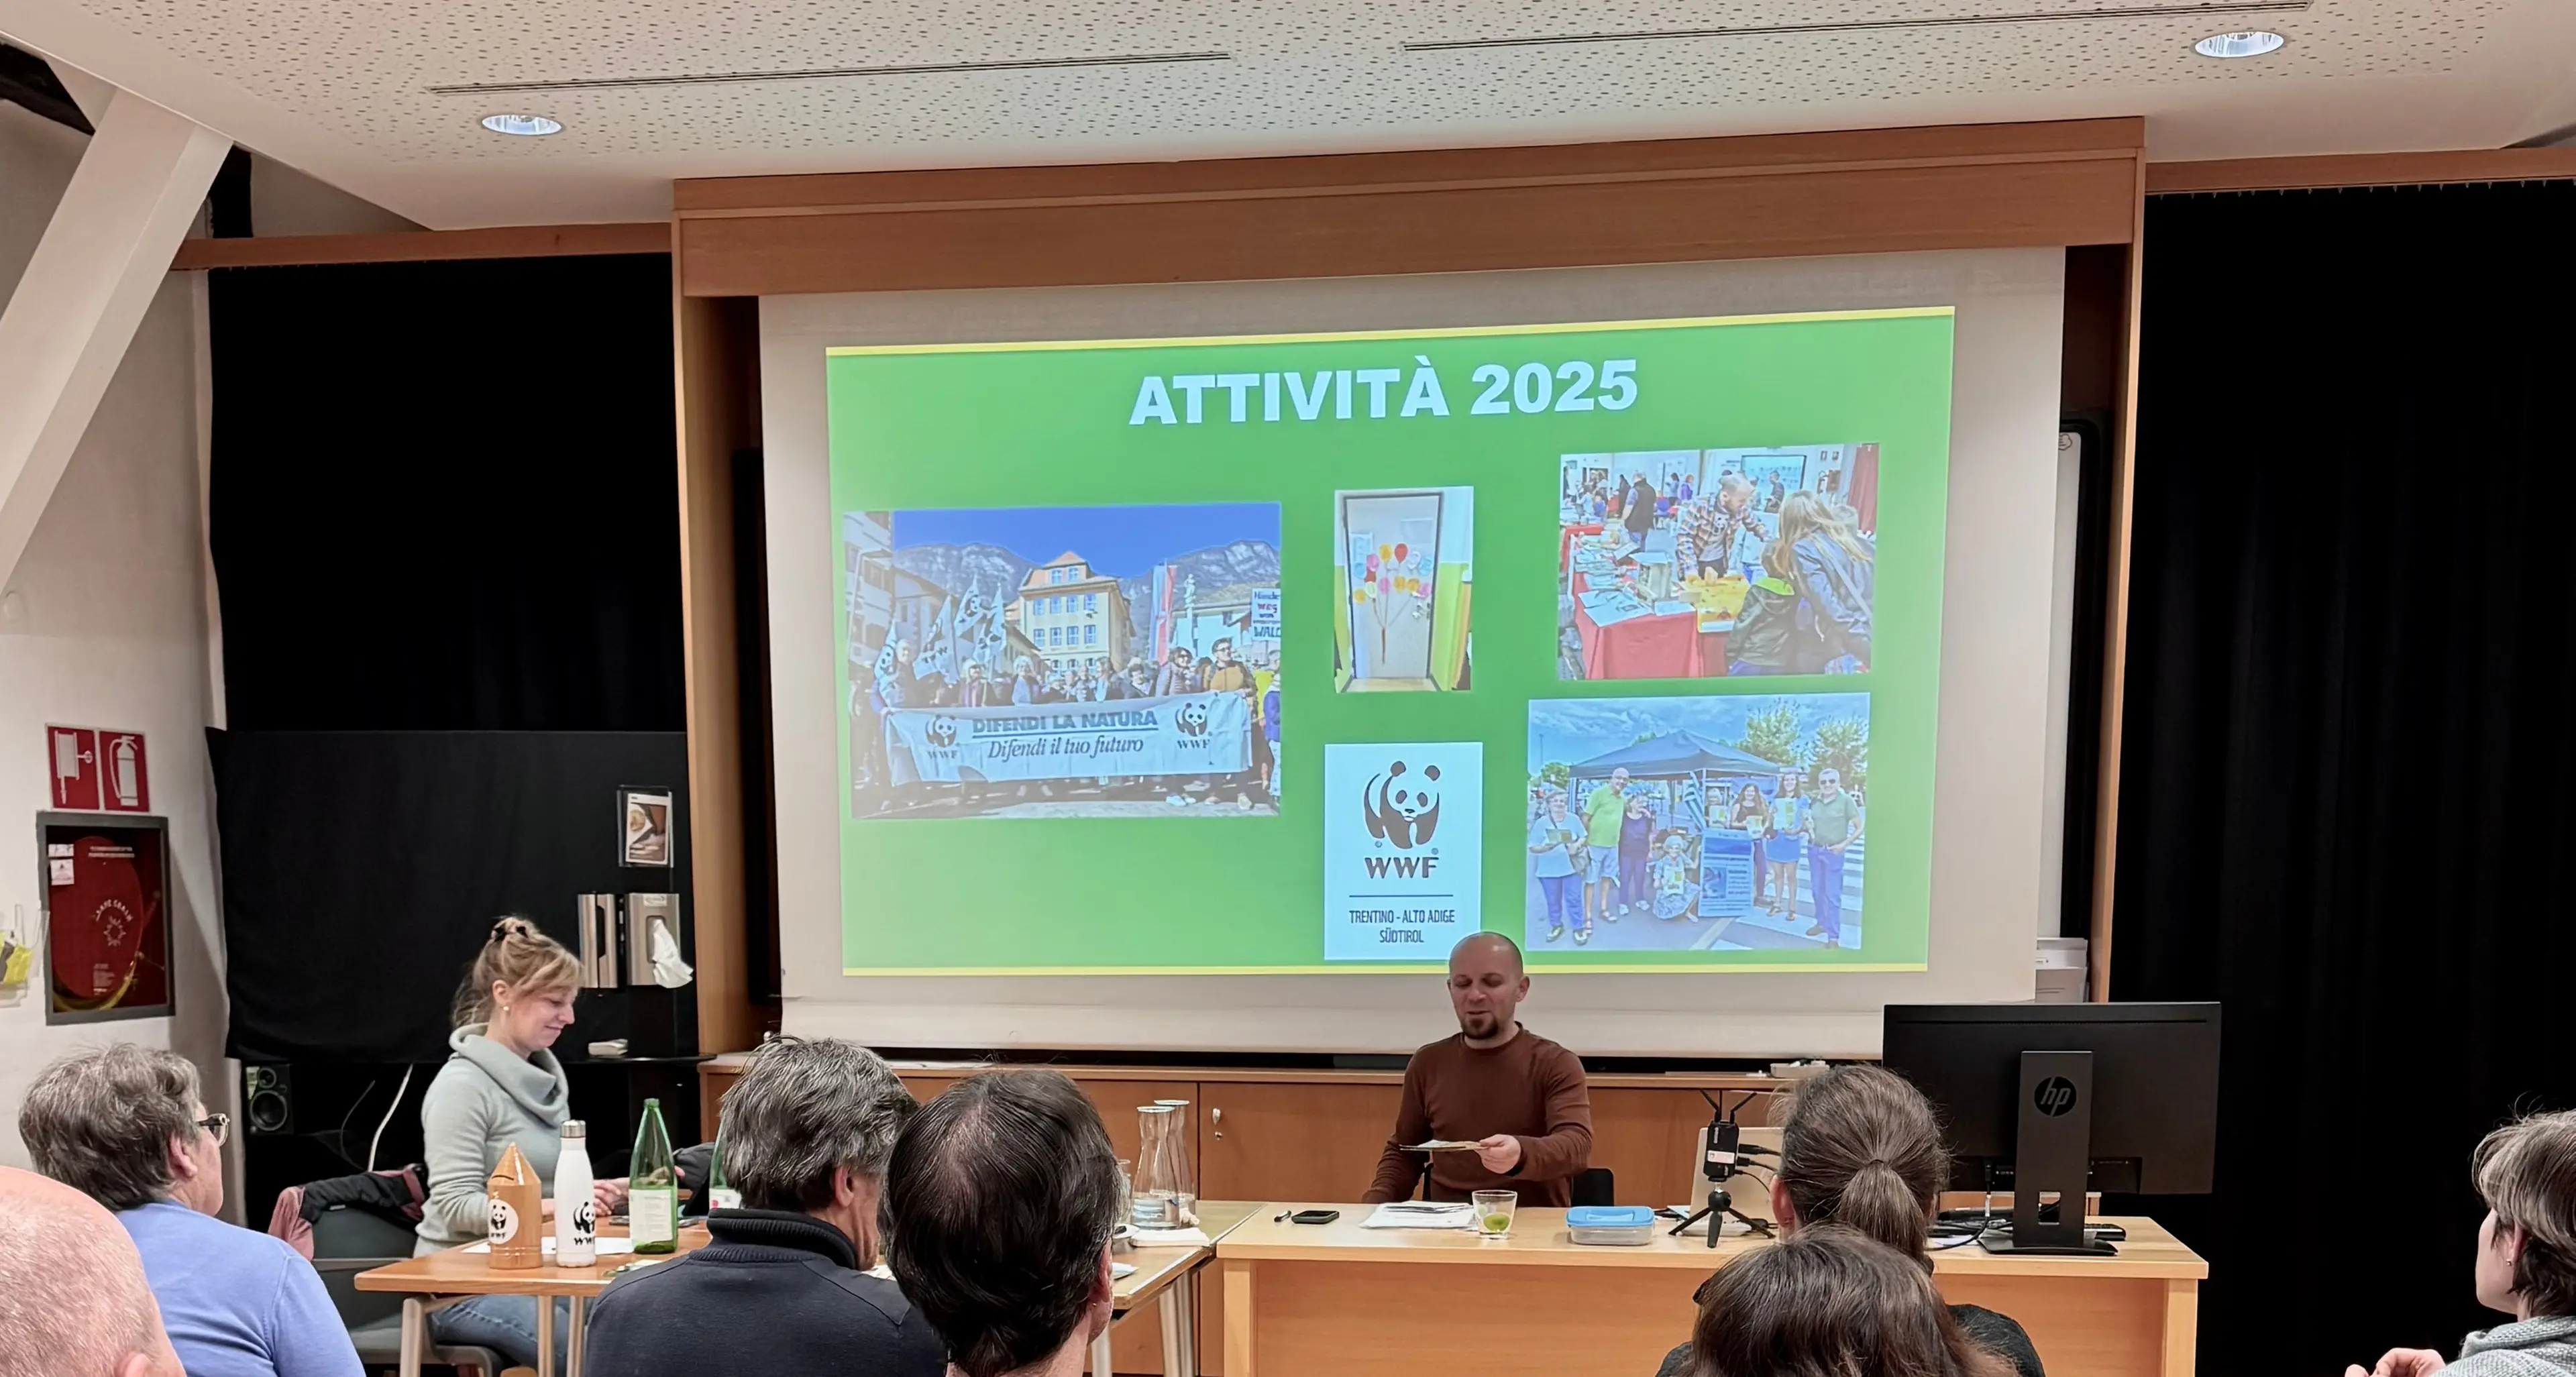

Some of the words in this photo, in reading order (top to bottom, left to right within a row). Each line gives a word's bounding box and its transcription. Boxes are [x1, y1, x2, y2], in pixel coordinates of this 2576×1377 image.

[1129, 355, 1450, 425] ATTIVITÀ
[1470, 359, 1638, 415] 2025
[973, 716, 1046, 733] DIFENDI
[1053, 714, 1077, 730] LA
[1081, 710, 1159, 727] NATURA
[988, 738, 1046, 762] Difendi
[1050, 736, 1062, 755] il
[1064, 739, 1091, 754] tuo
[1089, 735, 1144, 759] futuro
[1177, 739, 1210, 749] WWF
[1364, 857, 1440, 879] WWF
[1349, 910, 1395, 924] TRENTINO
[1402, 910, 1426, 924] ALTO
[1428, 910, 1455, 923] ADIGE
[1379, 928, 1424, 943] SÜDTIROL
[2040, 1077, 2072, 1117] hp
